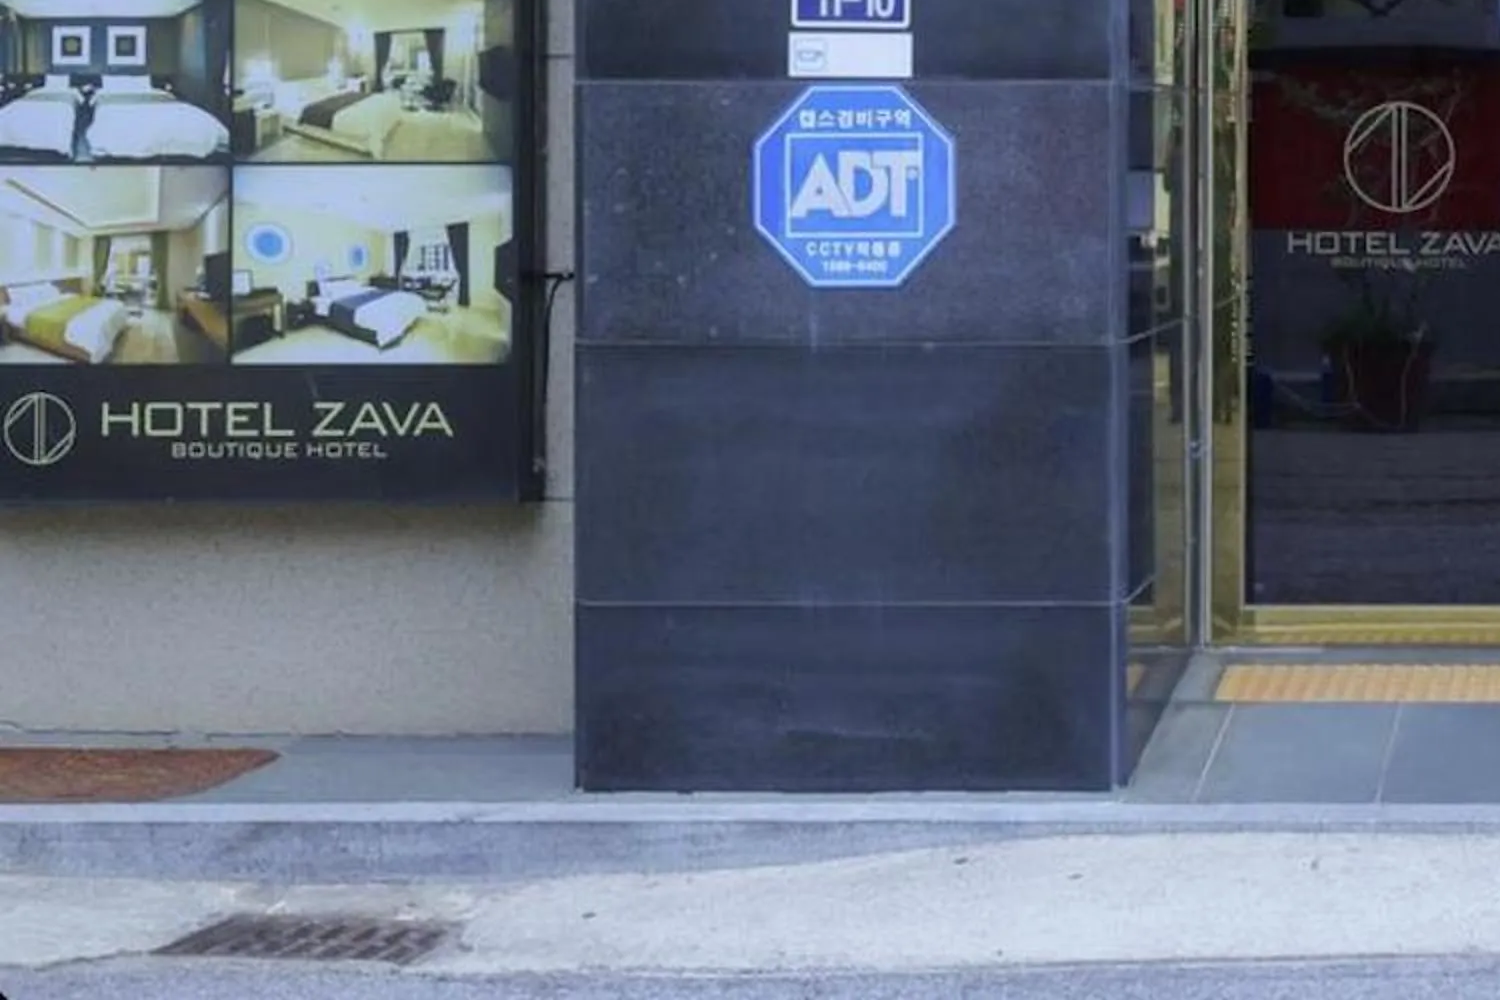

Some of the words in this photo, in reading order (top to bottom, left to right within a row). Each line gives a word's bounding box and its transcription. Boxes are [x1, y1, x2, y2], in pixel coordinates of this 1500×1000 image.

[790, 150, 921, 218] ADT
[1287, 231, 1411, 255] HOTEL
[101, 401, 295, 437] HOTEL
[312, 401, 454, 437] ZAVA
[171, 441, 297, 460] BOUTIQUE
[306, 441, 388, 459] HOTEL
